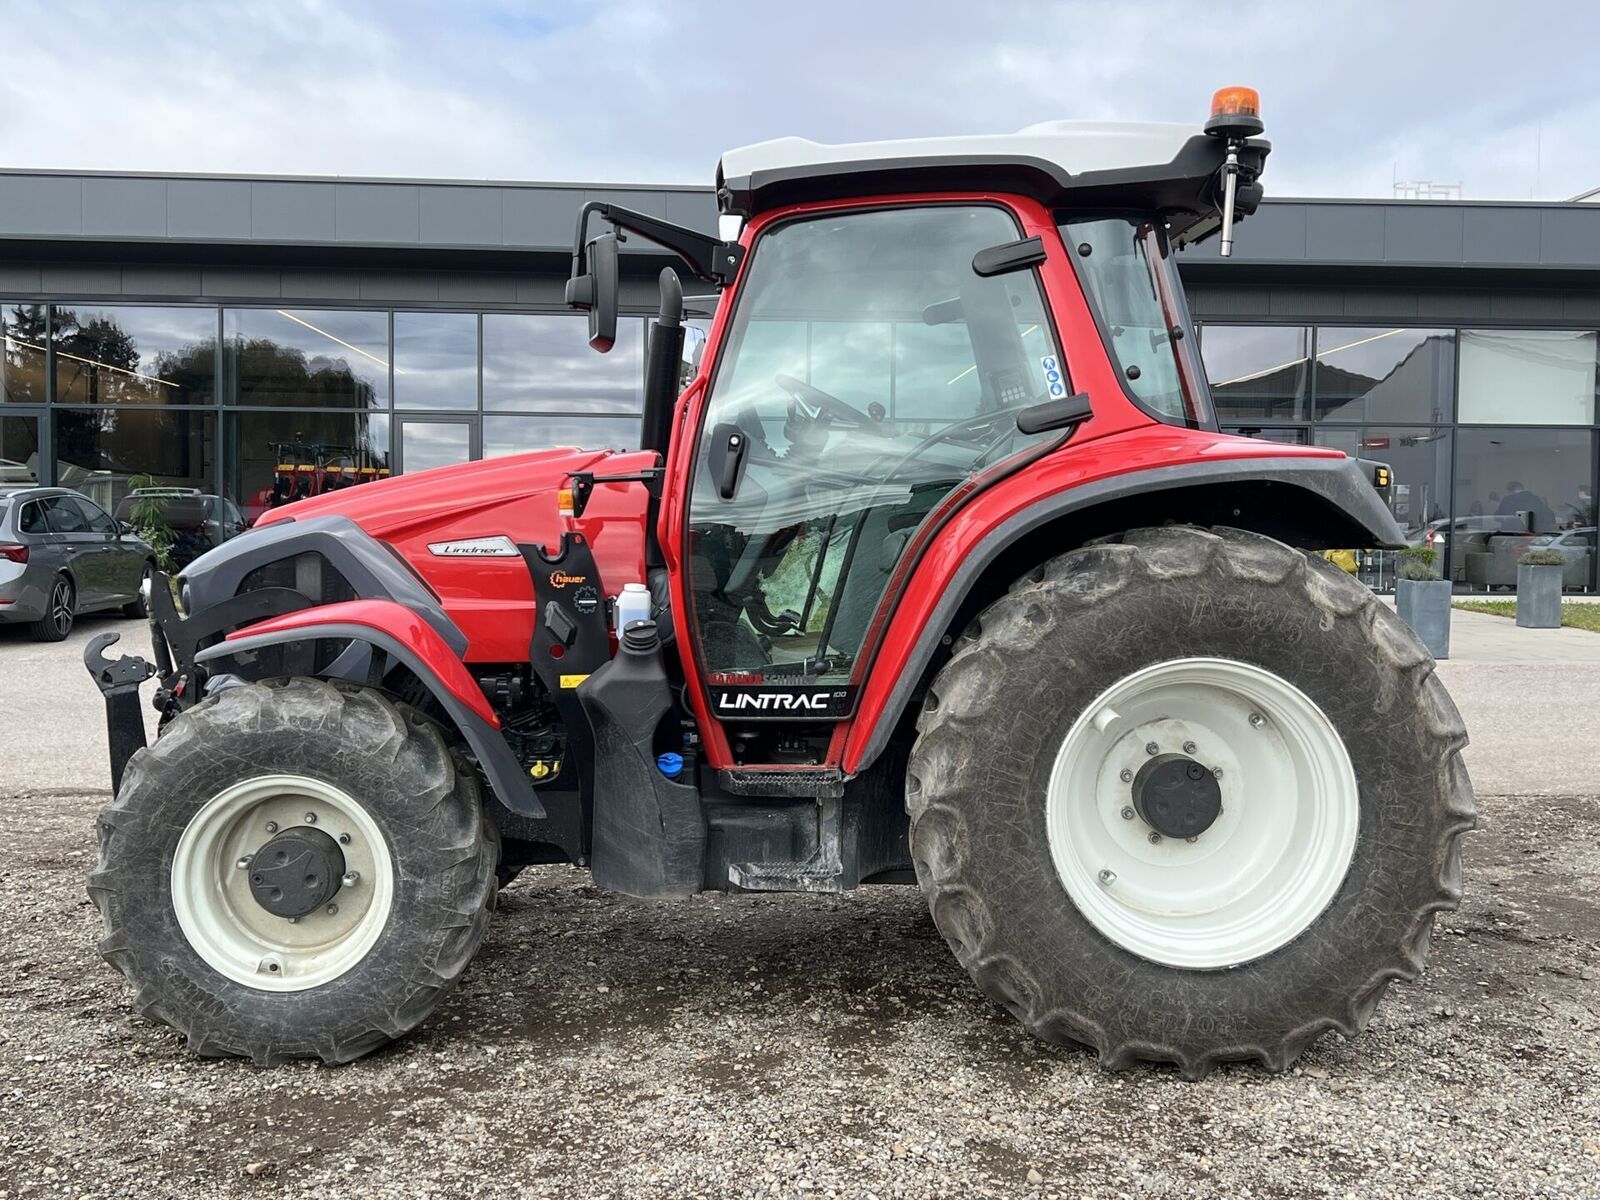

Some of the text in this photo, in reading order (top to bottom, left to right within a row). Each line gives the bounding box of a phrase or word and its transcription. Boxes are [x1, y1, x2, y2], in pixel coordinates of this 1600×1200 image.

[444, 545, 504, 554] Lindner
[555, 573, 587, 583] hauer
[719, 693, 830, 709] LINTRAC
